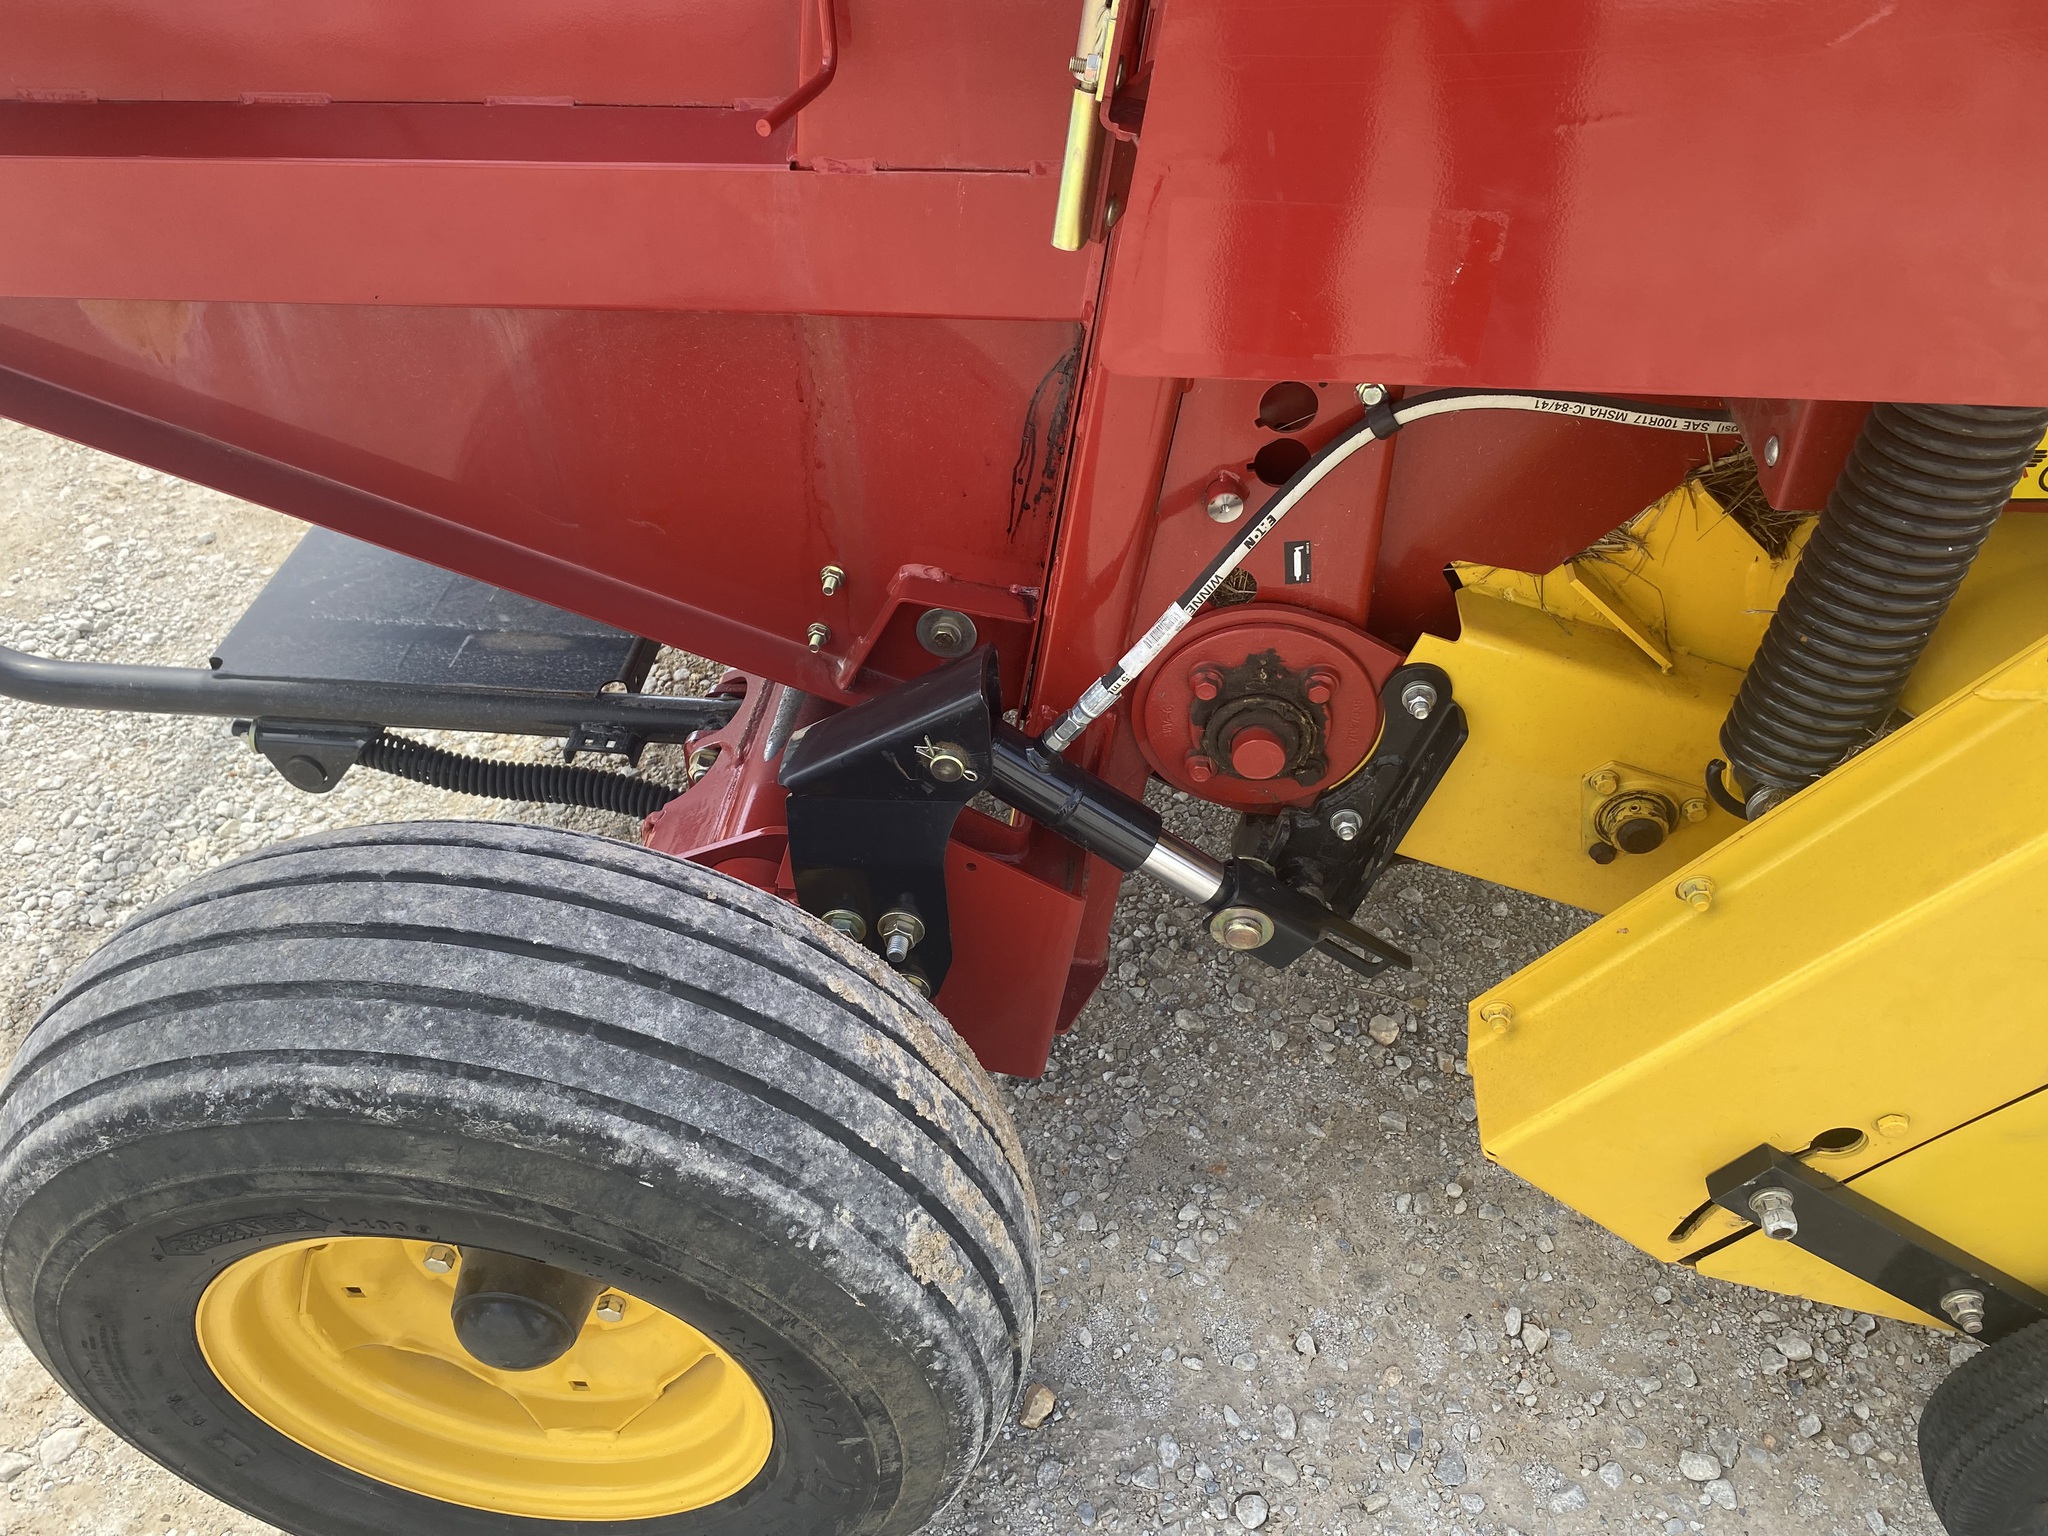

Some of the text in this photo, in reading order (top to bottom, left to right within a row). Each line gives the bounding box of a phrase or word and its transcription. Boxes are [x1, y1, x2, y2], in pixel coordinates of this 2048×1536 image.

[1535, 400, 1585, 415] IC-84/41
[1590, 407, 1628, 421] MSHA
[1634, 415, 1677, 428] 100R17
[1682, 421, 1709, 431] SAE
[543, 1239, 666, 1285] IMPLEMENT
